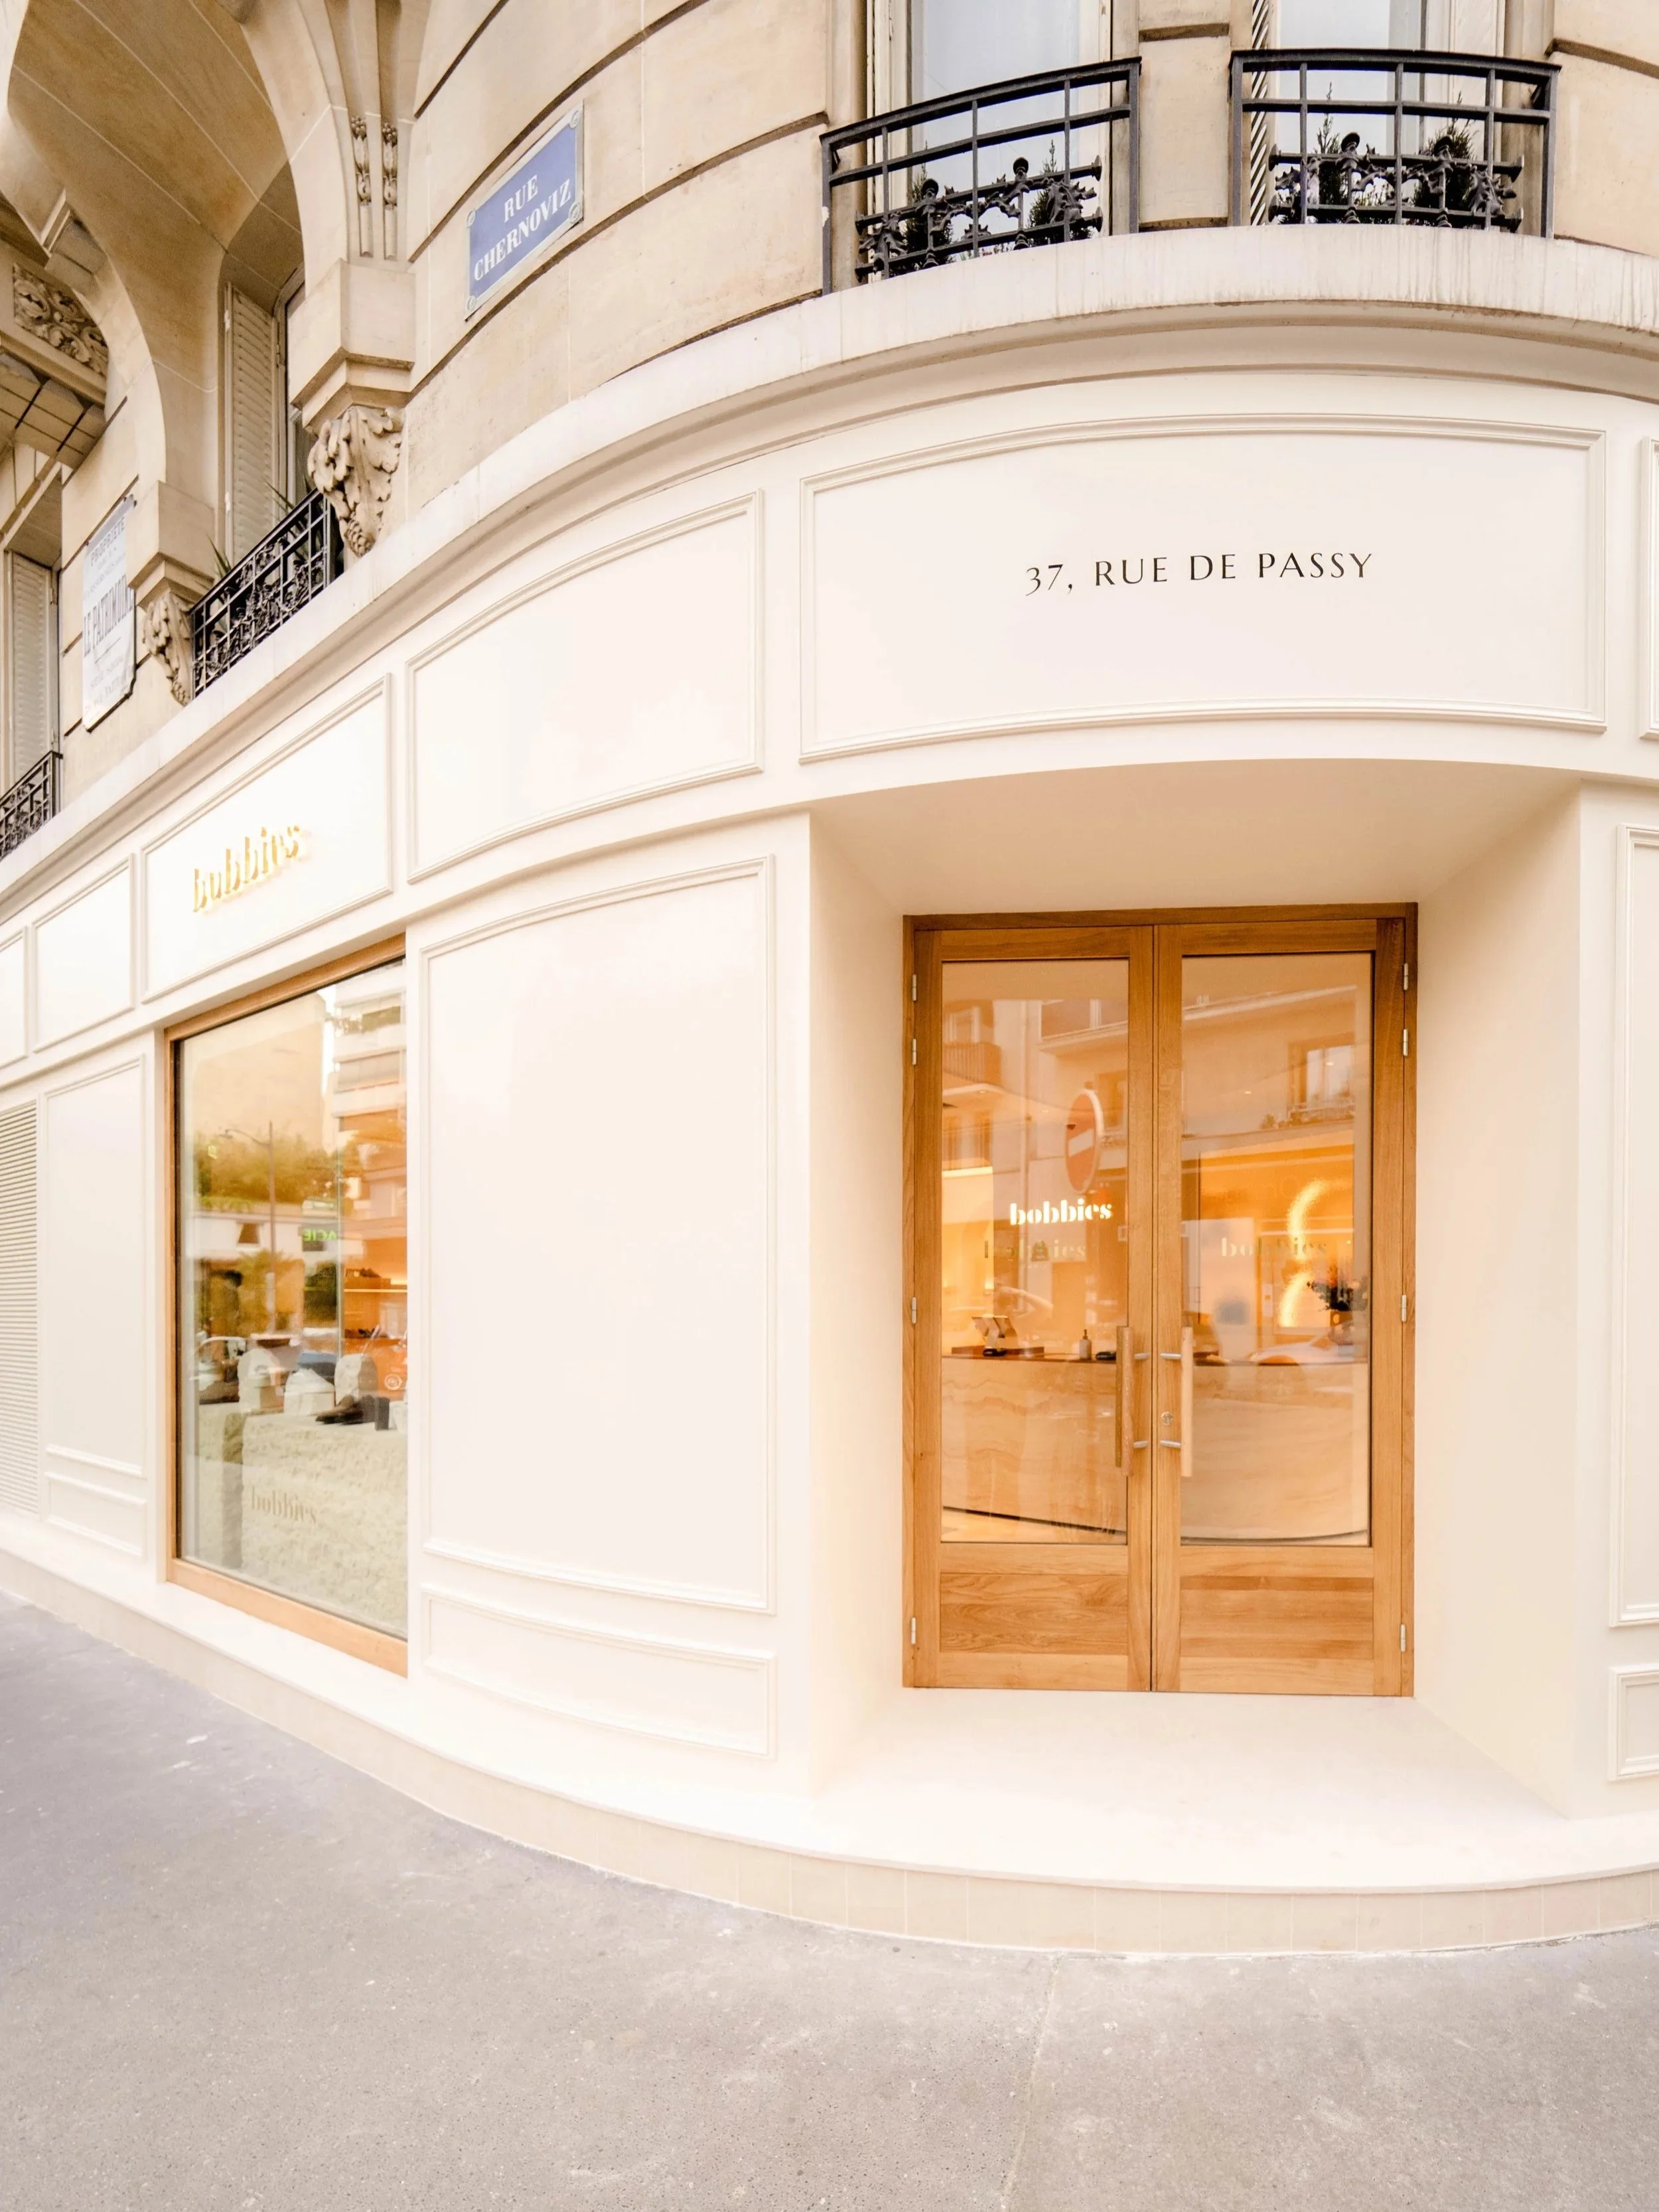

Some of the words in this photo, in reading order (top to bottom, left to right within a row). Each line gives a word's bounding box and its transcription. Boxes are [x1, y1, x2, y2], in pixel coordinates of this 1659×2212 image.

[504, 175, 538, 223] RUE
[474, 179, 571, 281] CHERNOVIZ
[1026, 563, 1072, 596] 37,
[1095, 557, 1167, 587] RUE
[1190, 553, 1236, 581] DE
[1258, 552, 1372, 579] PASSY
[84, 611, 91, 658] LE
[193, 825, 301, 913] bobbies
[1009, 1197, 1113, 1226] bobbies
[252, 1484, 317, 1525] bobbies
